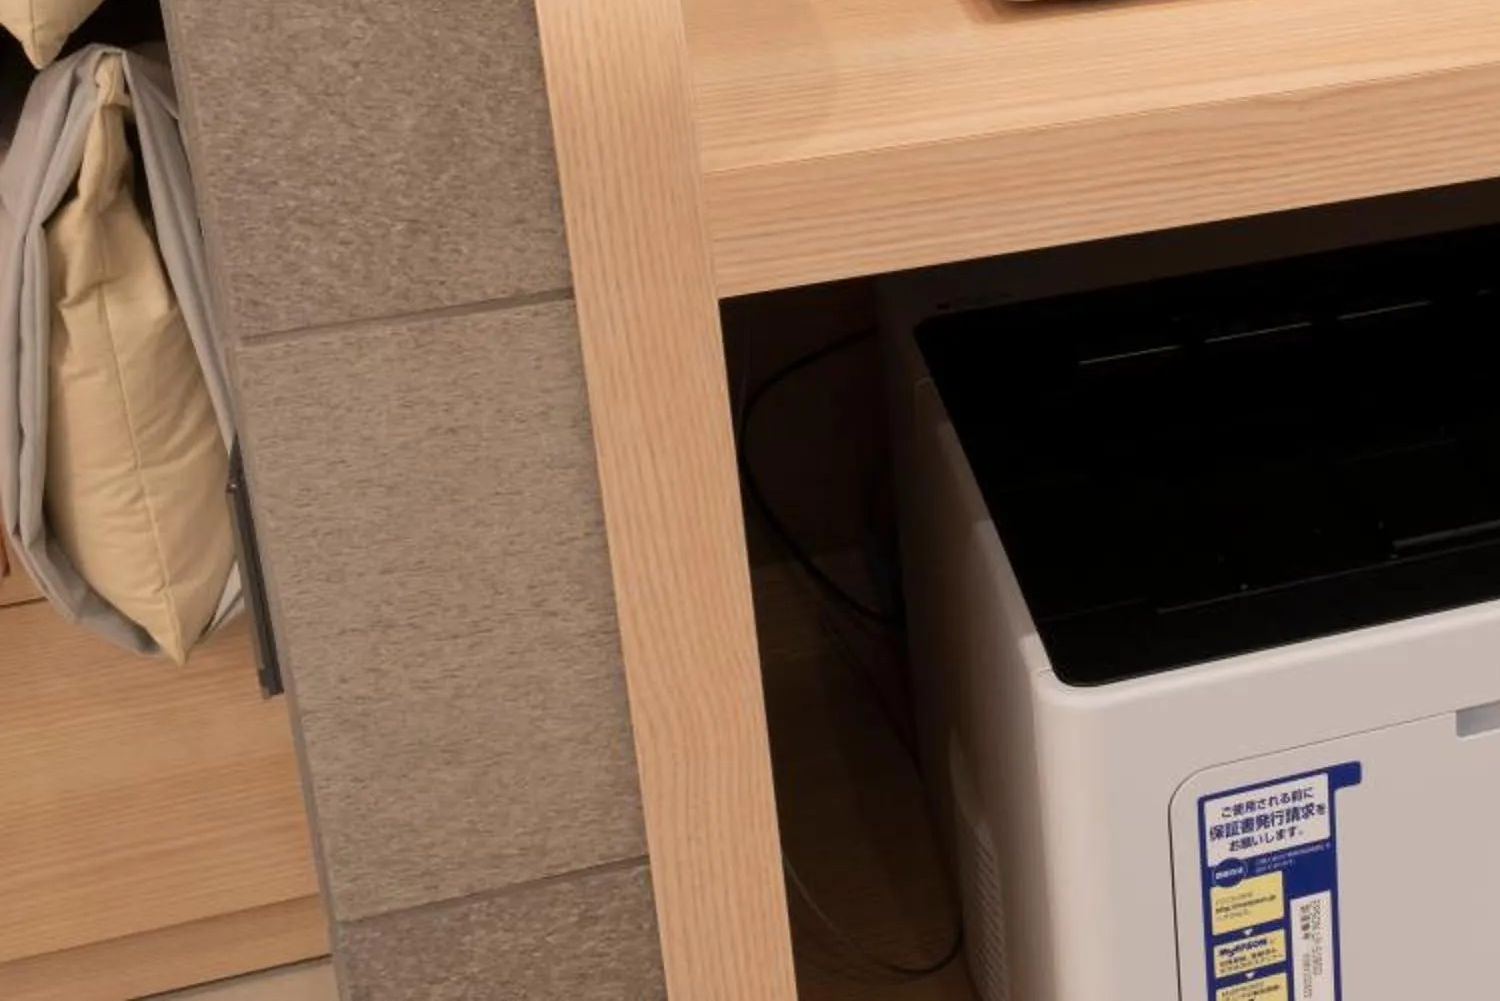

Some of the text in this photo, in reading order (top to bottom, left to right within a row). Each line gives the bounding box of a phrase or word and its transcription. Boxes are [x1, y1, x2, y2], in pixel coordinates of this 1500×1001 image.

[1221, 786, 1314, 818] ご使用される前に
[1209, 802, 1326, 842] 保証書発行請求を
